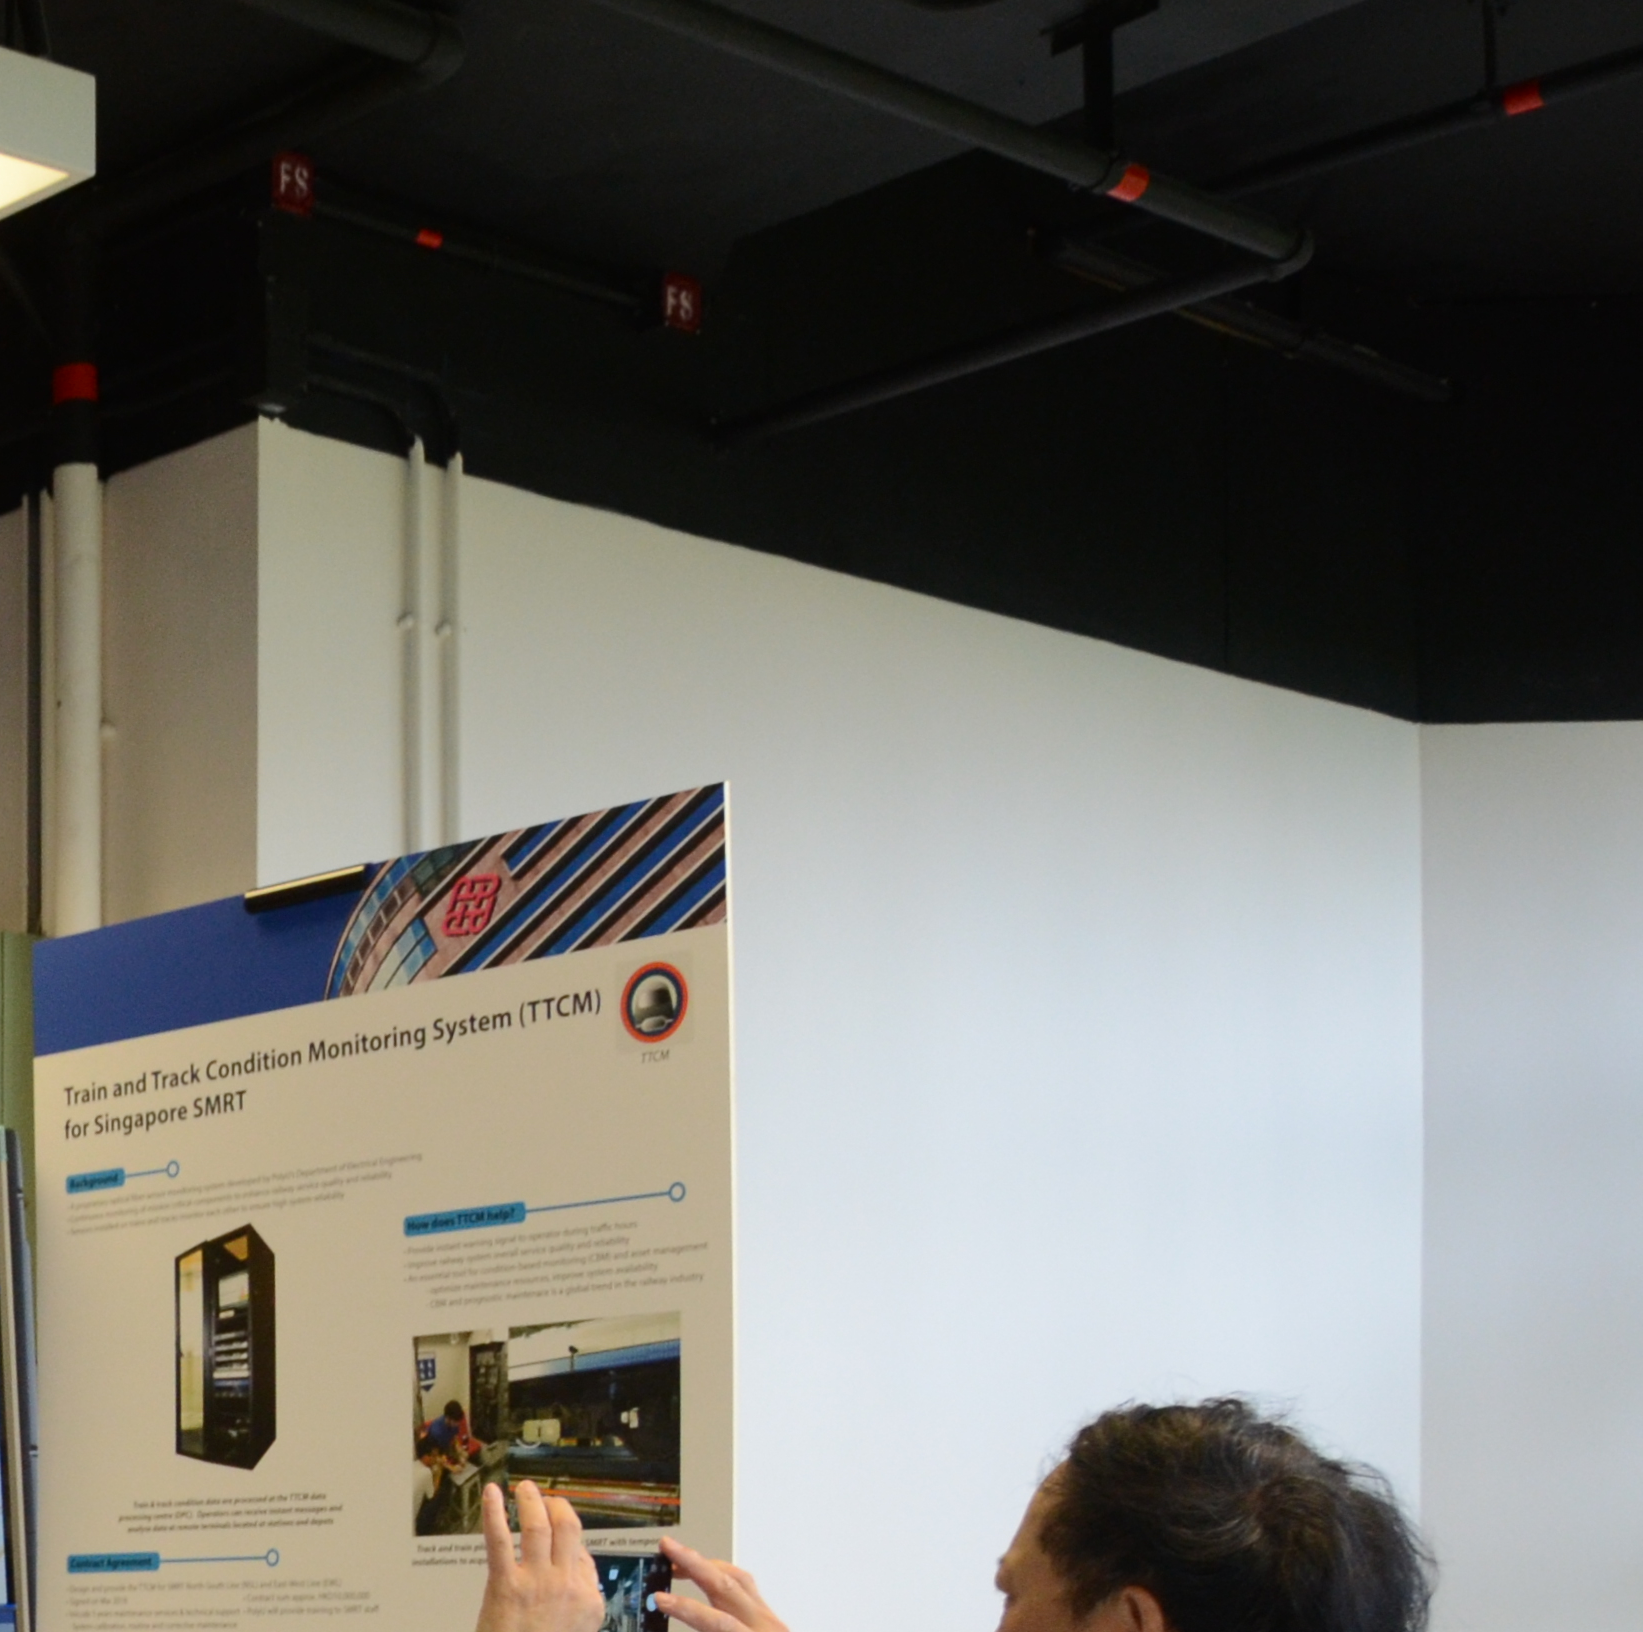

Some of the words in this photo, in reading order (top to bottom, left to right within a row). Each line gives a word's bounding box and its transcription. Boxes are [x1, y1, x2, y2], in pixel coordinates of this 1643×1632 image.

[281, 162, 309, 199] FS
[667, 286, 693, 321] FS
[65, 1082, 108, 1106] Train
[112, 1073, 147, 1097] and
[151, 1063, 201, 1090] Track
[205, 1049, 303, 1081] Condition
[307, 1027, 427, 1063] Monitoring
[431, 1013, 513, 1045] System
[517, 992, 601, 1033] (TTCM)
[641, 1048, 669, 1064] TTCM
[65, 1118, 90, 1138] for
[94, 1105, 187, 1134] Singapore
[191, 1090, 247, 1118] SMRT
[69, 1173, 119, 1188] Background
[407, 1219, 429, 1230] How
[431, 1216, 455, 1227] does
[457, 1211, 485, 1224] TTCM
[487, 1208, 515, 1221] help?
[71, 1557, 104, 1568] Contract
[106, 1556, 152, 1569] Agreement
